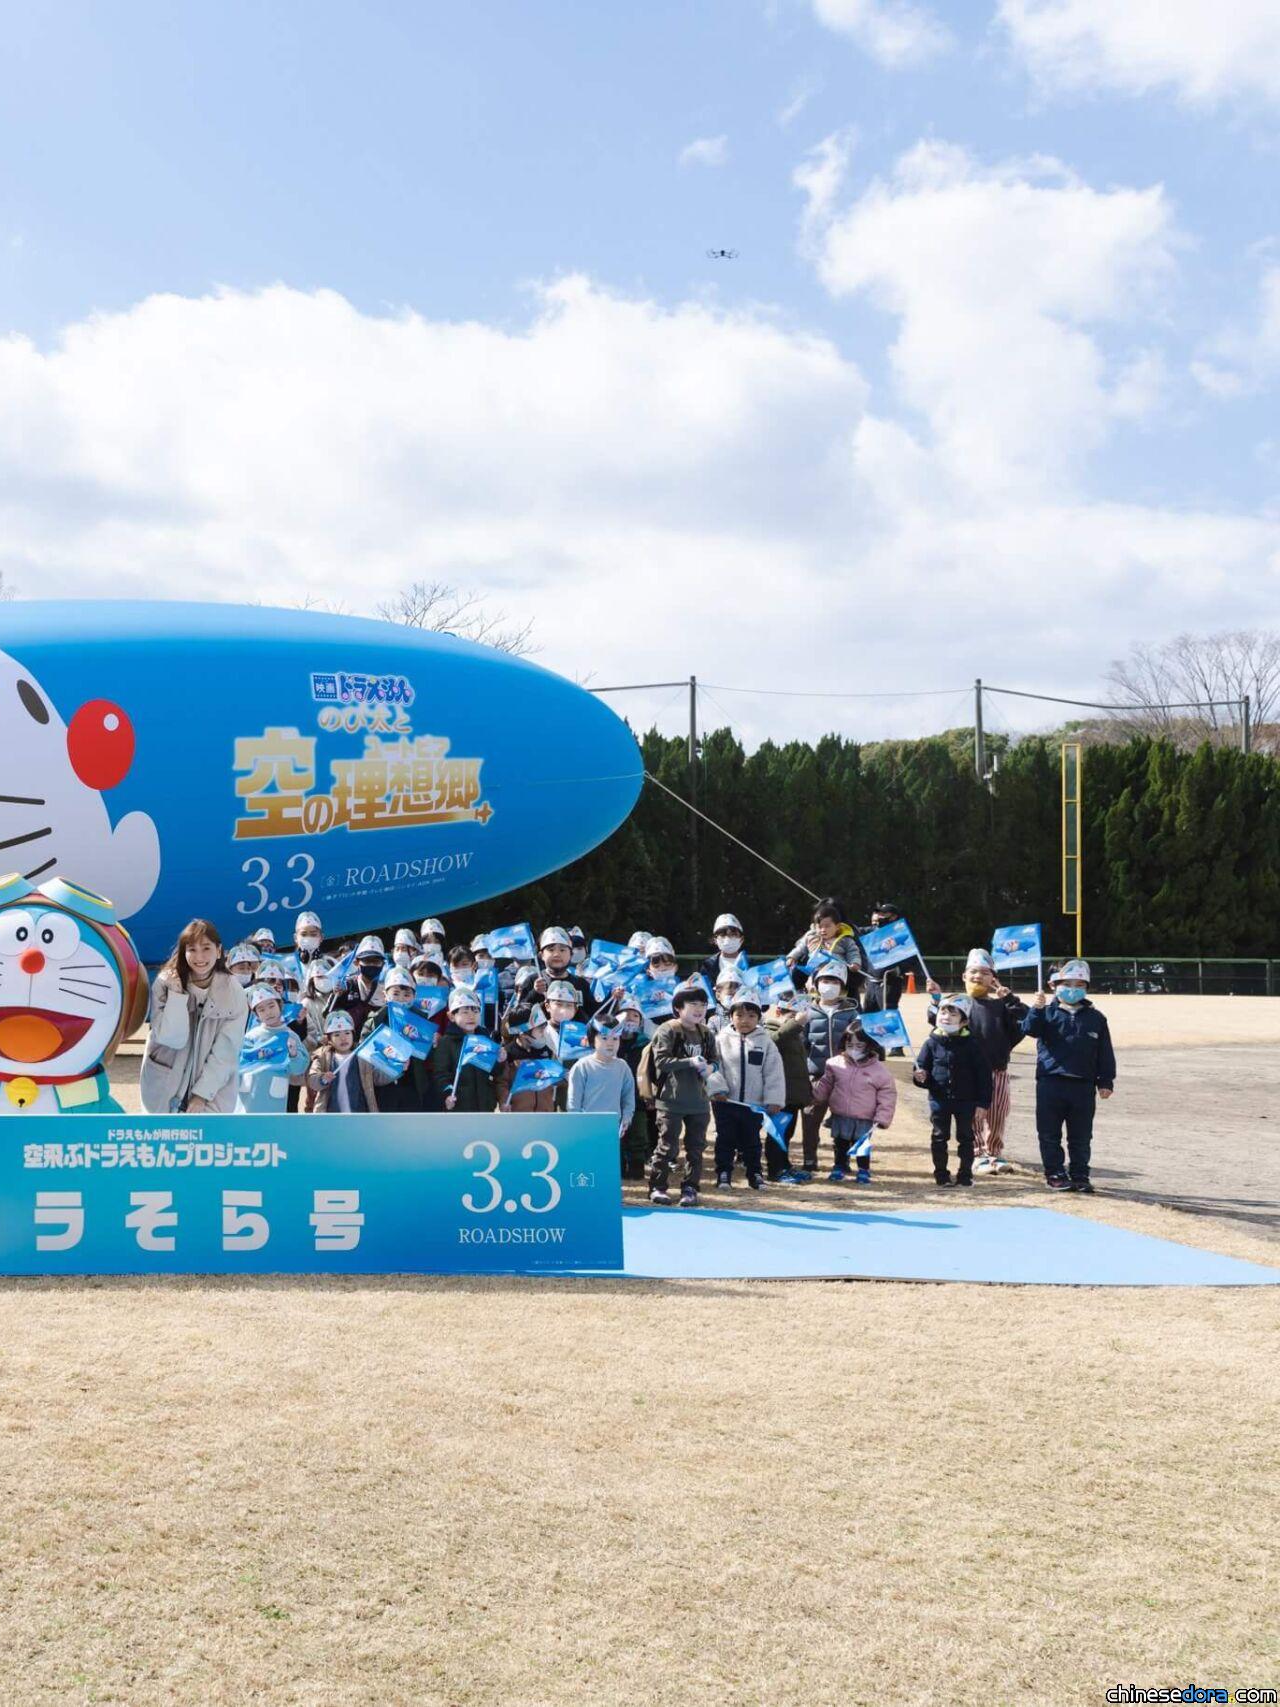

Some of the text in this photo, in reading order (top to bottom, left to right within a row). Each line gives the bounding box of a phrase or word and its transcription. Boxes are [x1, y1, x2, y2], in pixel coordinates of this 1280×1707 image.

[317, 703, 413, 733] のび太と
[233, 727, 484, 840] 空の理想郷
[236, 853, 315, 914] 3.3
[344, 852, 474, 887] ROADSHOW
[23, 1142, 288, 1169] 空飛ぶドラえもんプロジェクト
[461, 1140, 562, 1213] 3.3
[458, 1227, 567, 1244] ROADSHOW
